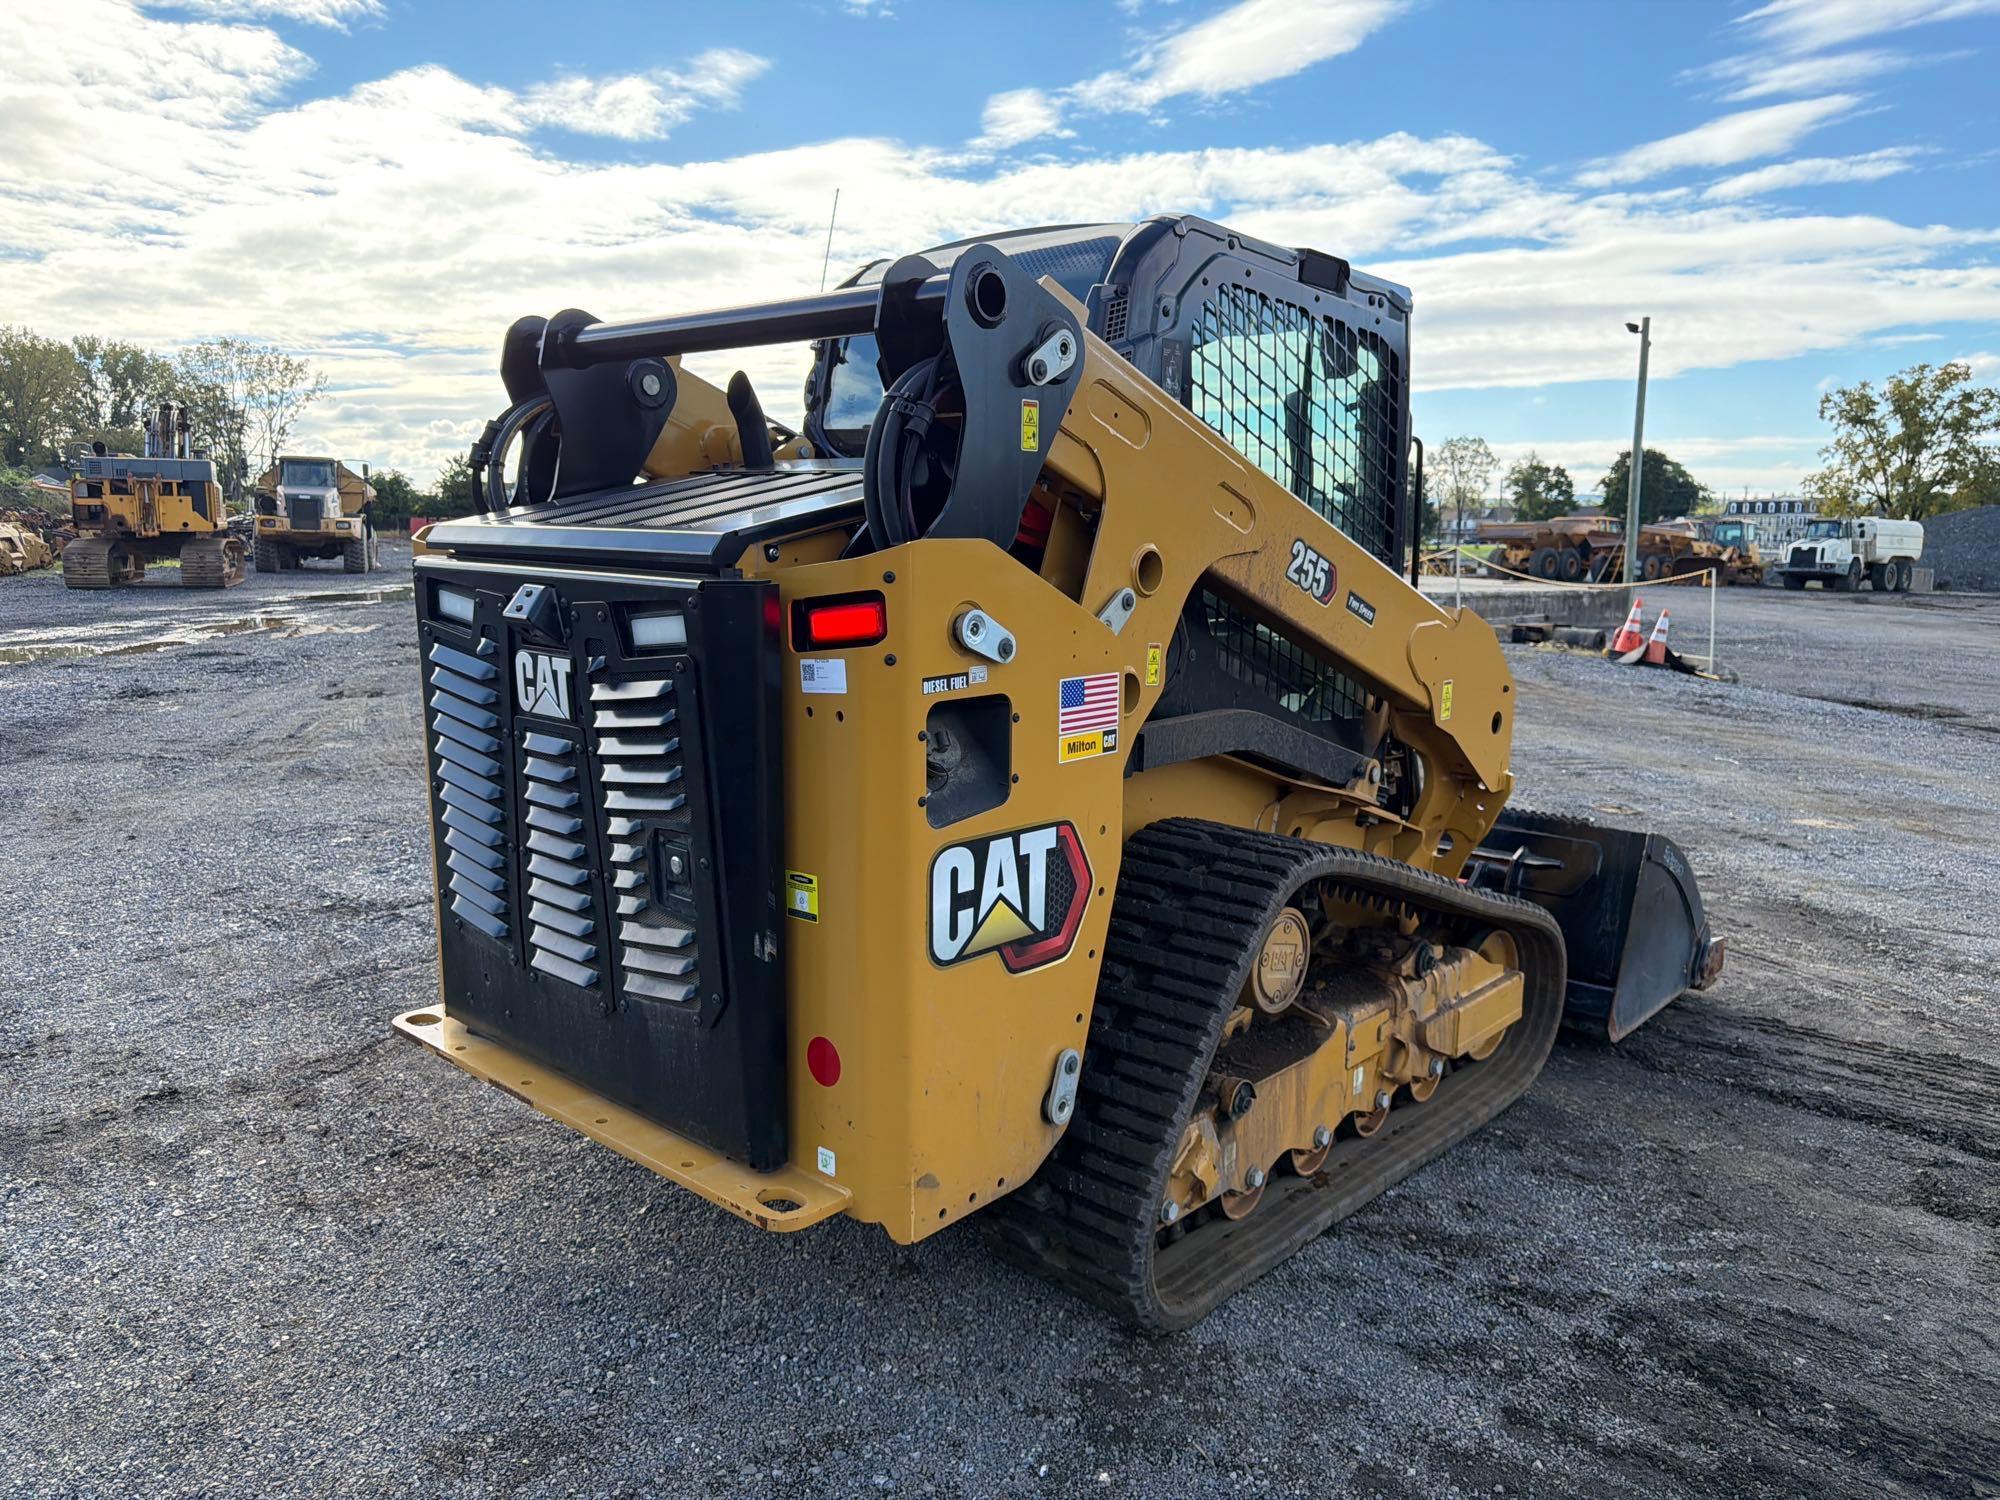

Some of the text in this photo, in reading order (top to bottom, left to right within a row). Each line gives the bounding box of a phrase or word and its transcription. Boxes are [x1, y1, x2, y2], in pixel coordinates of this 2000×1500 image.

[1286, 540, 1330, 598] 255
[515, 650, 571, 720] CAT
[923, 675, 967, 694] DIESEL FUEL
[1067, 734, 1116, 755] Milton CAT
[933, 826, 1057, 961] CAT
